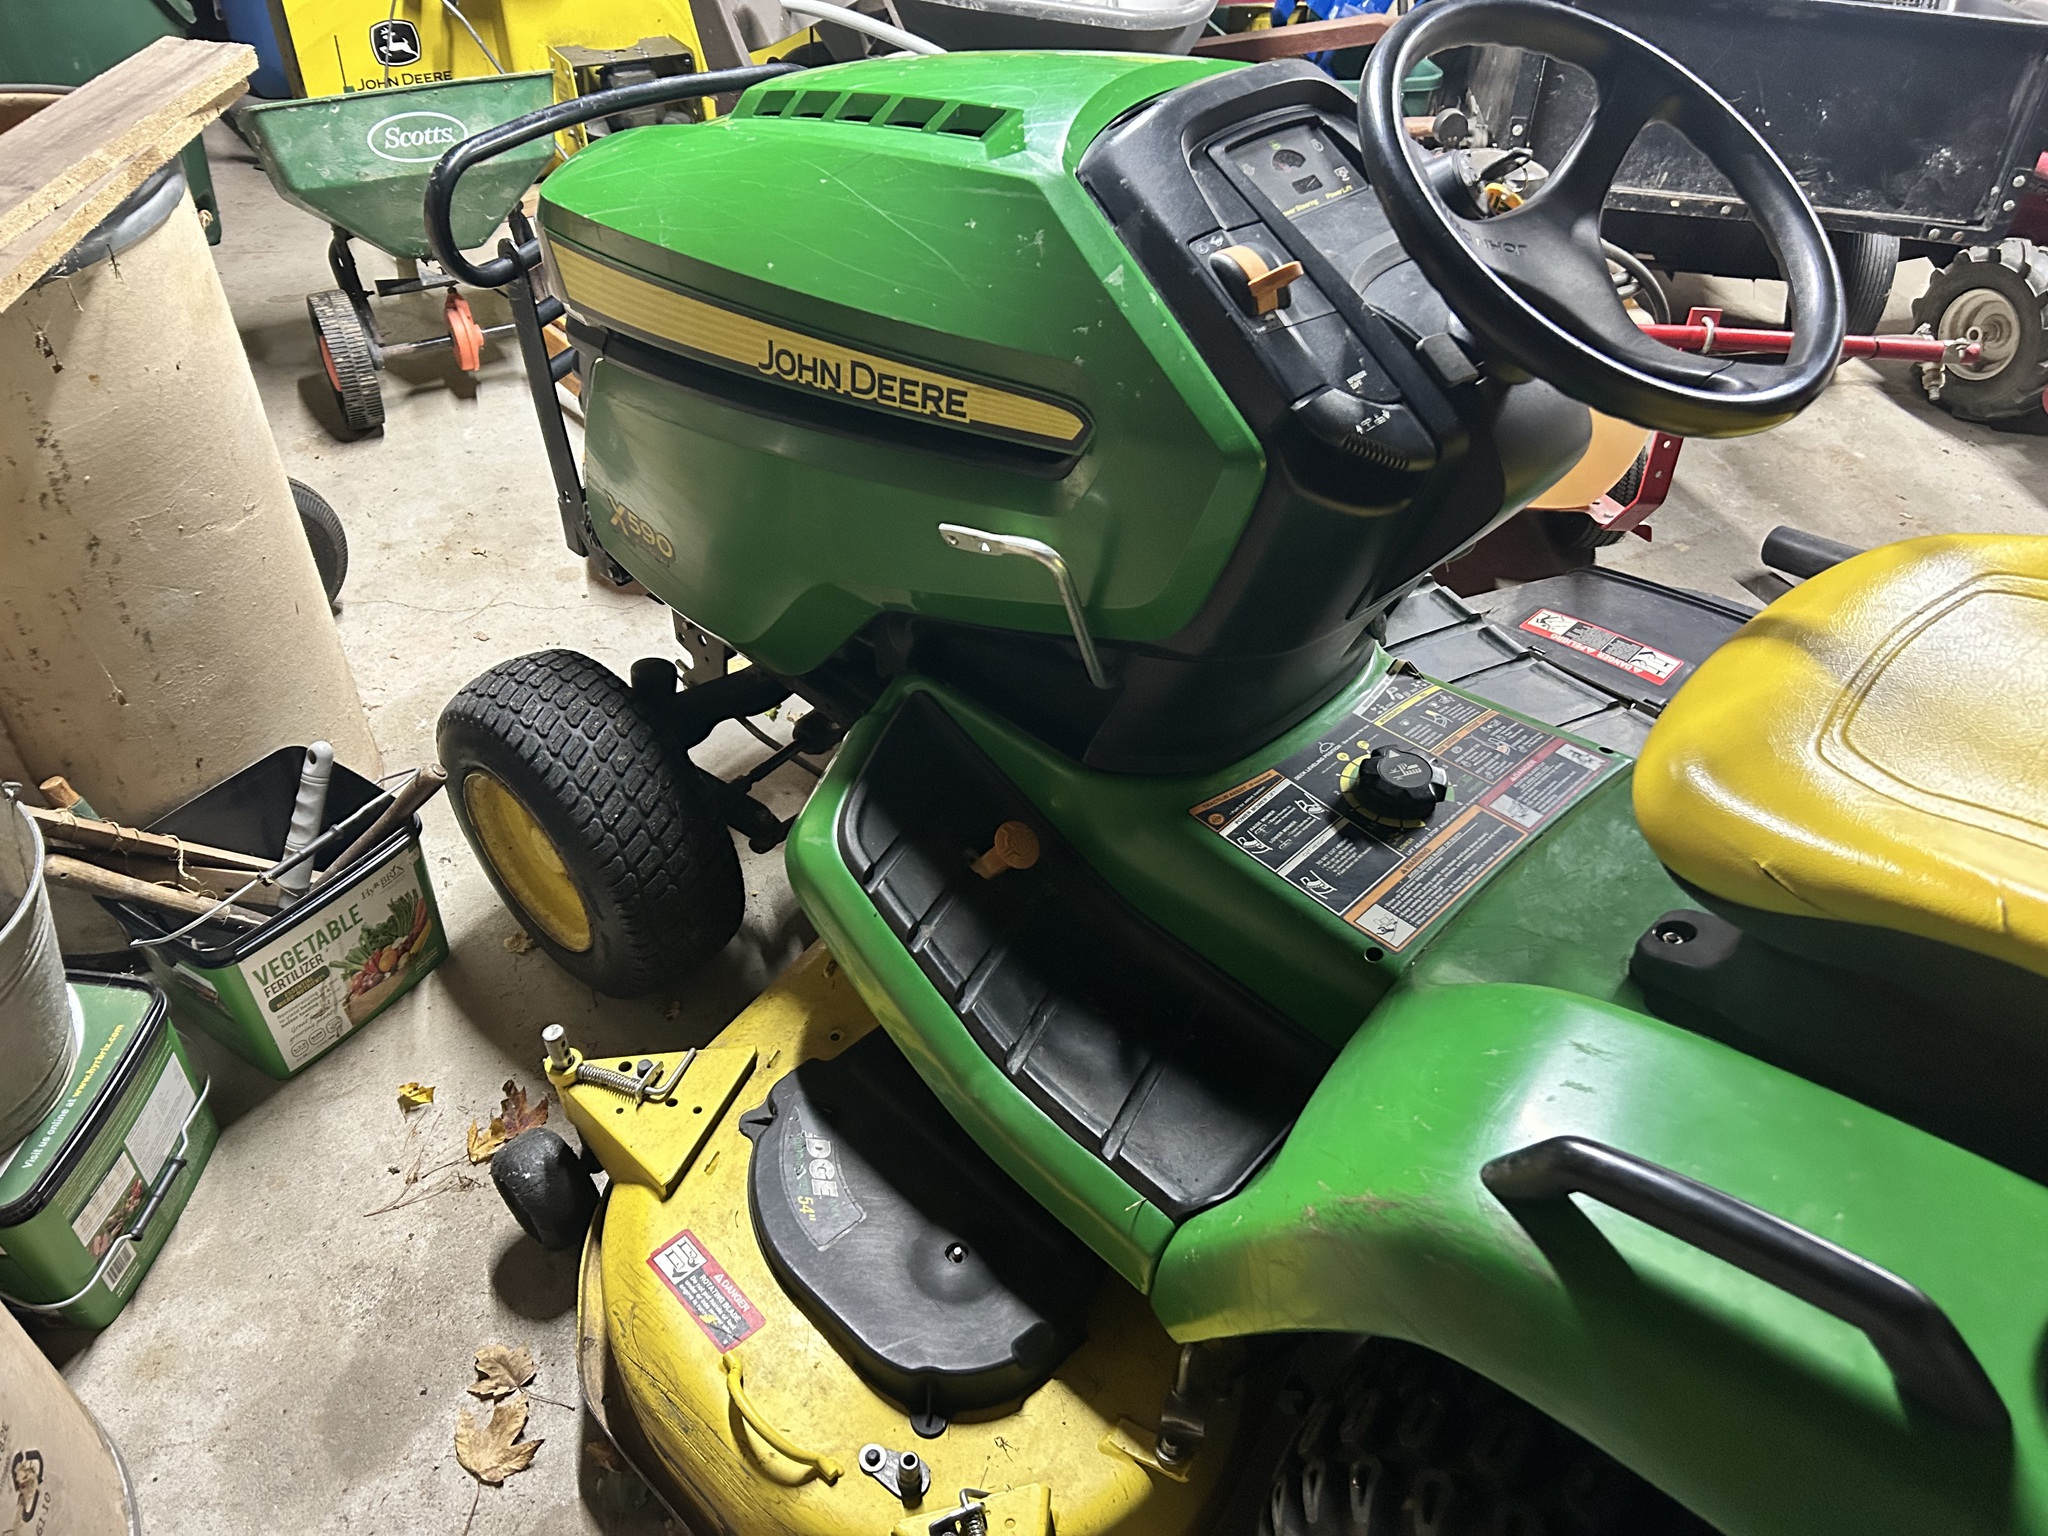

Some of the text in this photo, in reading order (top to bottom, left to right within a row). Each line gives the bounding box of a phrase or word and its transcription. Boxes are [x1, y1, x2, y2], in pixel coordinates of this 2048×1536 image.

[357, 71, 453, 91] JOHN DEERE
[384, 126, 453, 149] Scotts
[758, 340, 969, 420] JOHN DEERE
[603, 488, 677, 562] X590
[1549, 632, 1587, 652] PELIGRO
[1596, 650, 1632, 671] DANGER
[1234, 810, 1252, 824] POWER
[1250, 797, 1268, 811] MOWER
[1268, 820, 1297, 843] LOWER MOWER
[1403, 846, 1431, 869] WARNING
[251, 902, 366, 988] VEGETABLE
[262, 952, 325, 999] FERTILIZER
[71, 1021, 125, 1100] www.hyrbrix.com
[21, 1095, 76, 1172] Visit us online at
[806, 1132, 838, 1198] DGE
[694, 1281, 705, 1292] not
[701, 1289, 712, 1300] put
[708, 1298, 724, 1315] hands
[698, 1273, 742, 1324] ROTATING BLADE
[719, 1278, 750, 1312] DANGER
